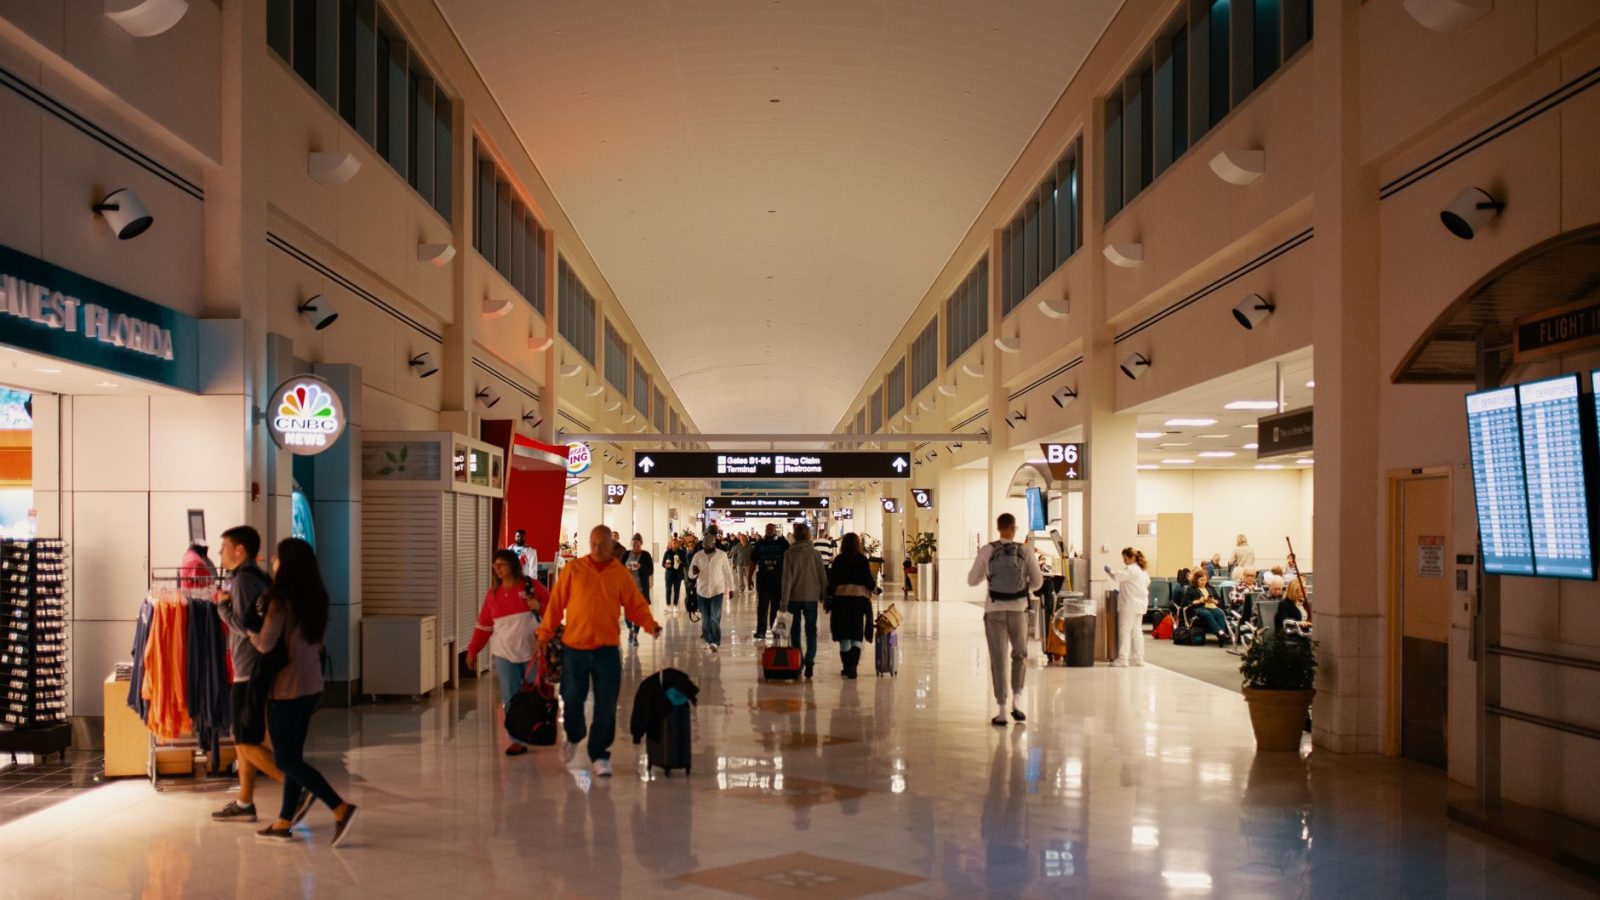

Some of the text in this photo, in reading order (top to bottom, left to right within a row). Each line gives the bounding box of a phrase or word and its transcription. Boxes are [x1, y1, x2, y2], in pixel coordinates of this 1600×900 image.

[84, 304, 174, 360] FLORIDA
[1540, 313, 1585, 344] FLIGHT
[276, 418, 335, 431] CNBC
[285, 432, 326, 446] NEWS
[569, 453, 588, 465] ING
[1048, 444, 1078, 464] B6
[727, 456, 771, 465] Gates B1-B4
[785, 456, 821, 466] Bag Claim
[727, 465, 756, 473] Terminal
[785, 465, 822, 473] Restrooms
[607, 485, 624, 496] B3
